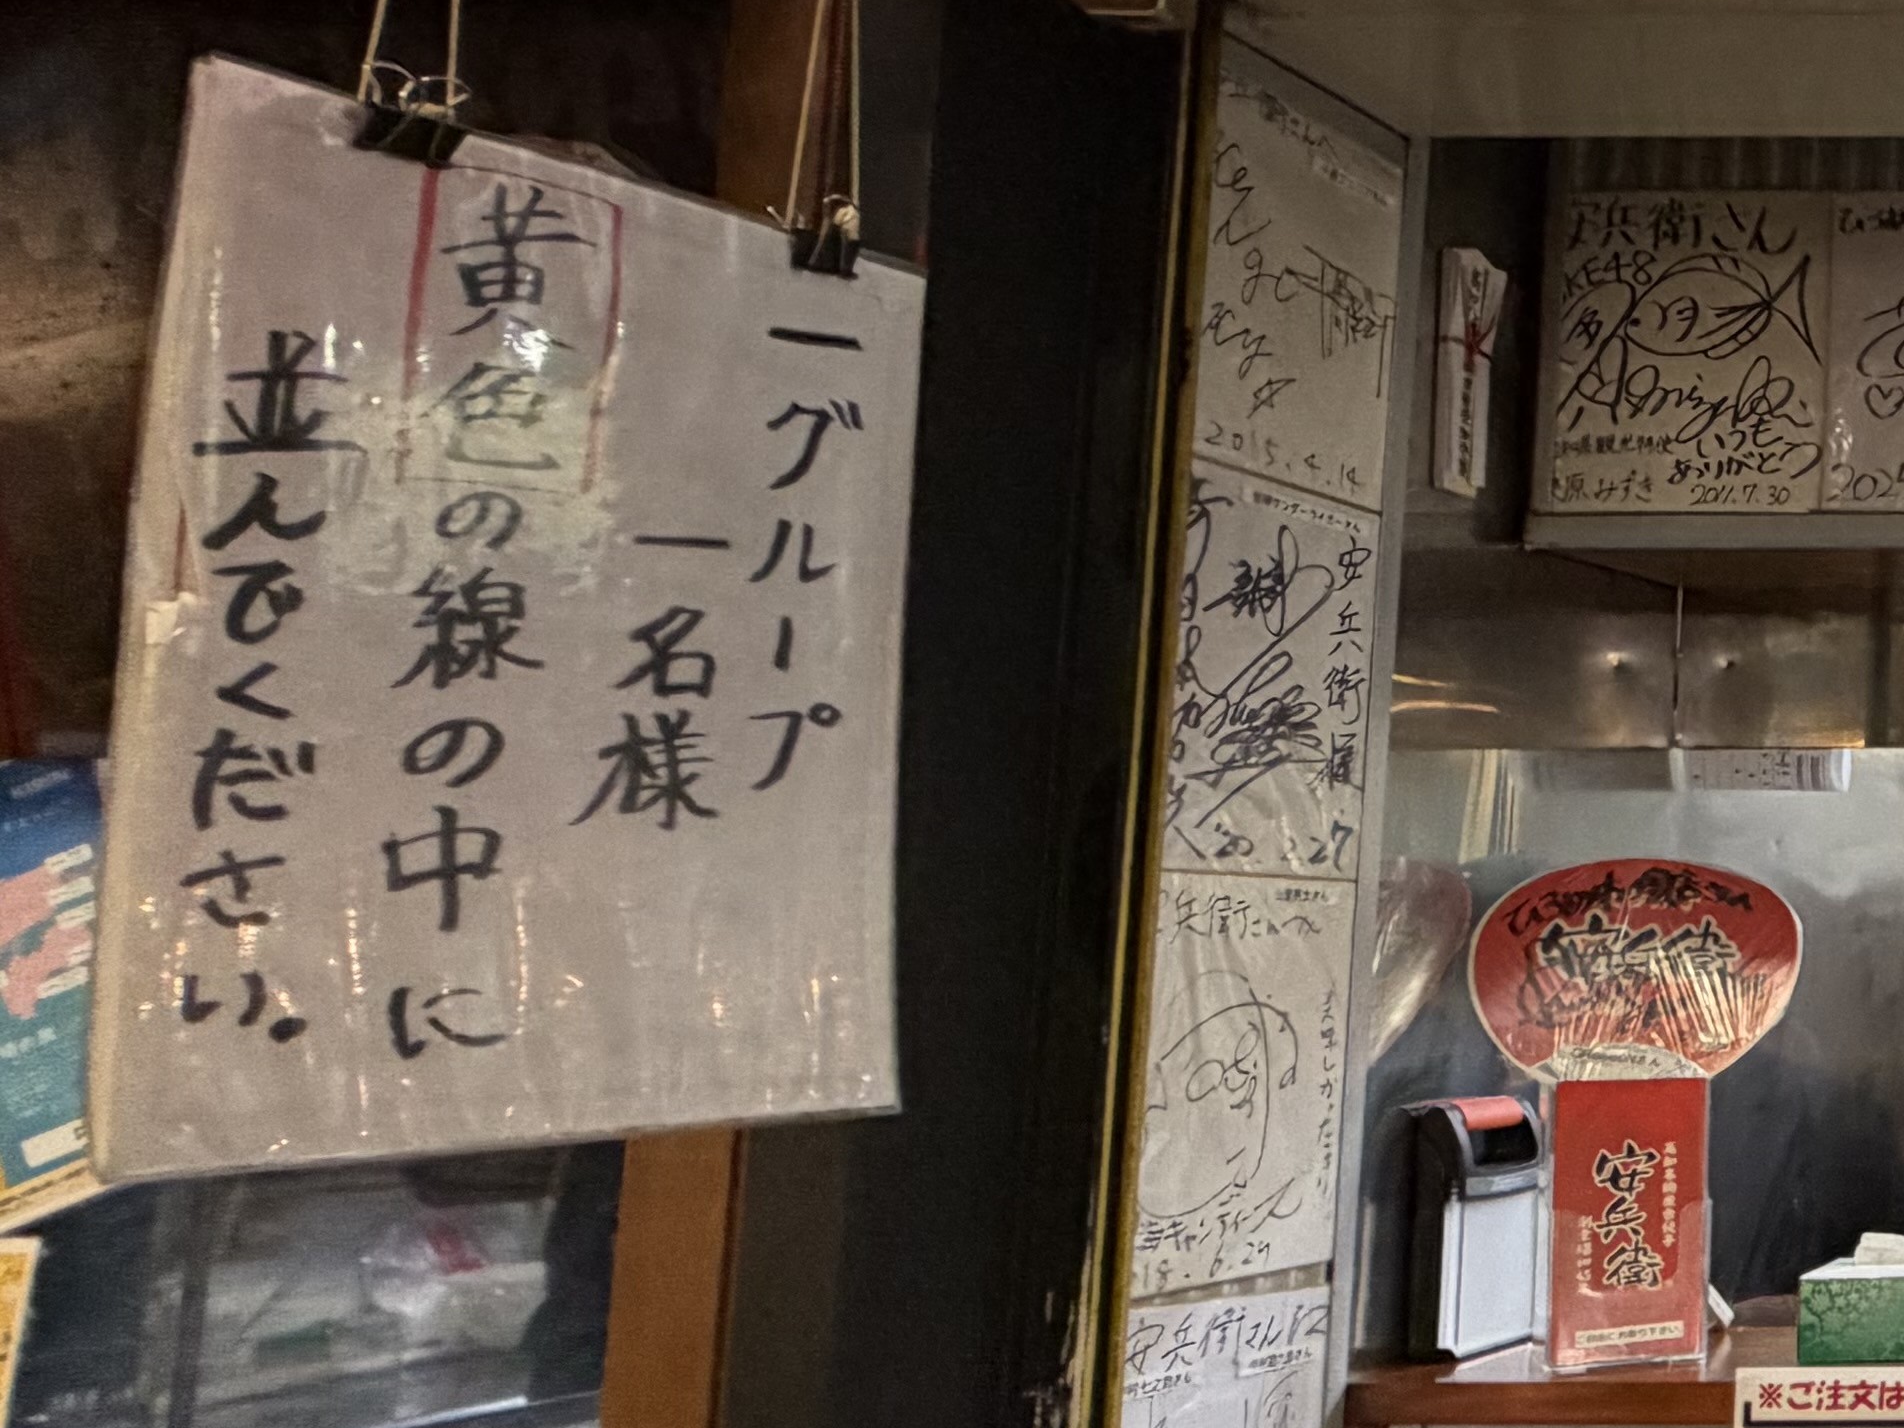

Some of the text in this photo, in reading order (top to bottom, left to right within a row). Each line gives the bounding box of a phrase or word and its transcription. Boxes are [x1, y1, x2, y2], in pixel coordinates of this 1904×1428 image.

[181, 329, 364, 1045] 並んでください。
[381, 182, 598, 1060] 黄色の線の中に
[571, 532, 730, 831] 一名様
[1592, 1138, 1664, 1291] 安兵衛
